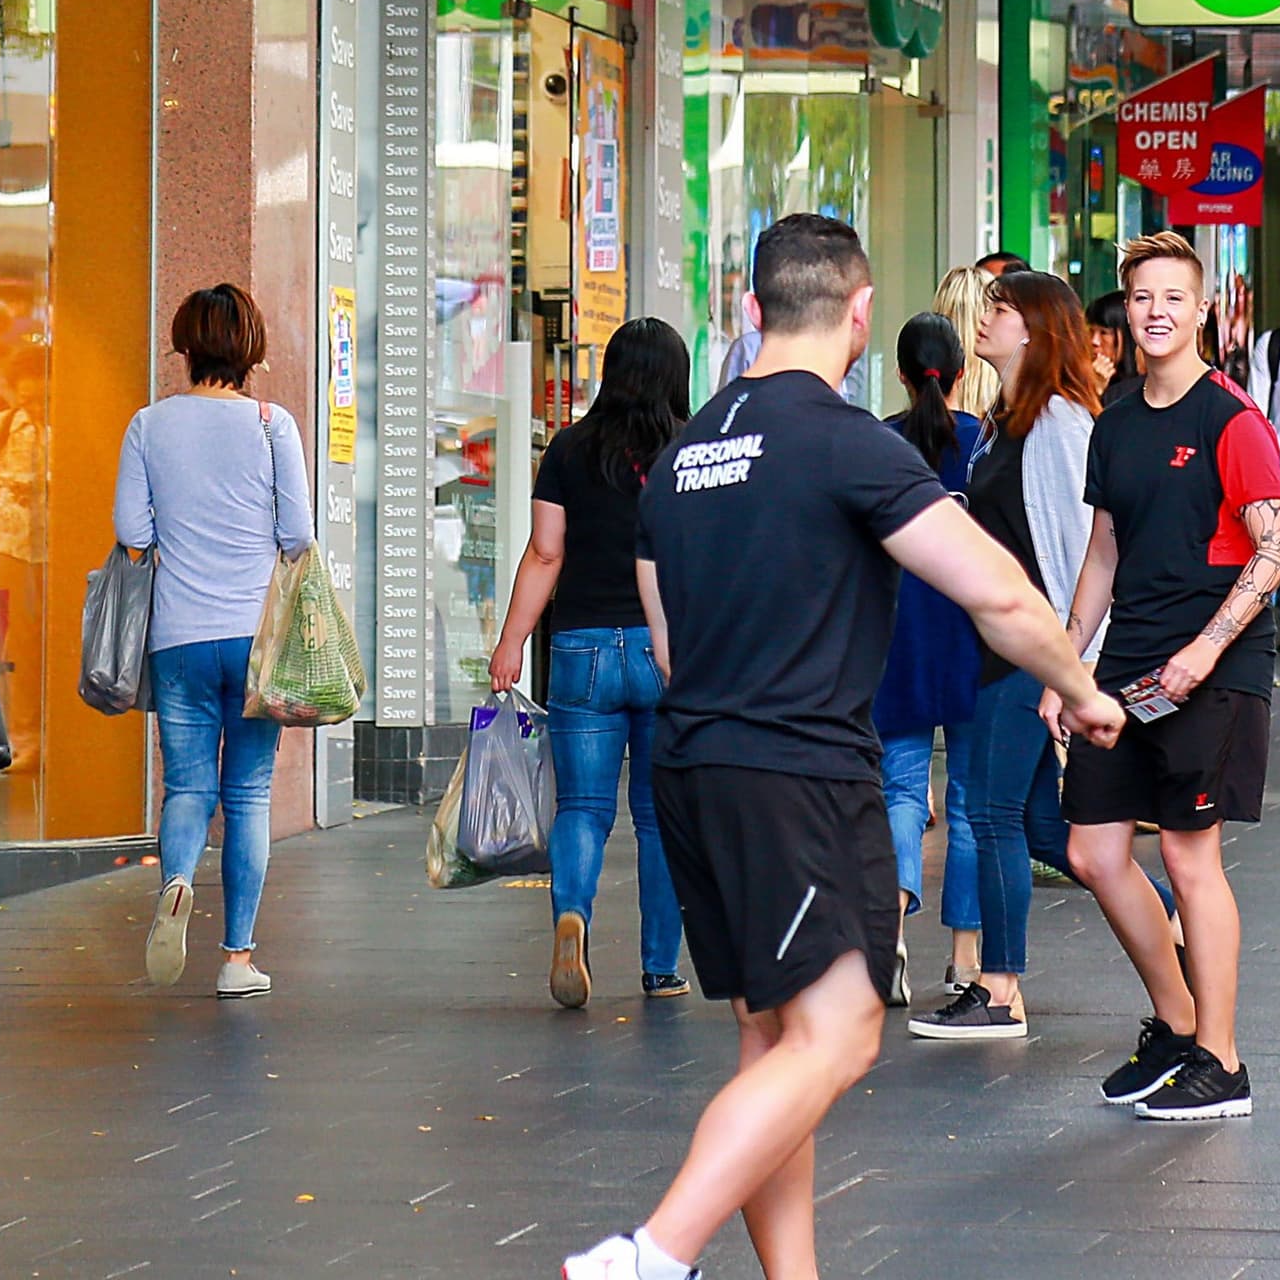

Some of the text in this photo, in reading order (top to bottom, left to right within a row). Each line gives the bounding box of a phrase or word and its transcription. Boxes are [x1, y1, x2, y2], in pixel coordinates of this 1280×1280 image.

[385, 3, 419, 17] Save
[385, 23, 419, 37] Save
[331, 25, 354, 68] Save
[385, 43, 419, 57] Save
[385, 63, 419, 77] Save
[385, 83, 419, 97] Save
[331, 91, 354, 134] Save
[385, 103, 419, 116] Save
[1121, 102, 1209, 123] CHEMIST
[385, 123, 419, 136] Save
[1135, 131, 1197, 150] OPEN
[385, 143, 419, 156] Save
[385, 162, 419, 176] Save
[330, 156, 353, 198] Save
[385, 182, 419, 196] Save
[385, 203, 419, 216] Save
[385, 223, 419, 236] Save
[329, 222, 353, 265] Save
[384, 243, 418, 256] Save
[384, 263, 418, 276] Save
[384, 283, 418, 296] Save
[384, 303, 418, 316] Save
[384, 323, 418, 337] Save
[384, 343, 418, 357] Save
[384, 363, 418, 376] Save
[384, 383, 418, 396] Save
[384, 403, 418, 417] Save
[384, 423, 418, 437] Save
[384, 443, 418, 457] Save
[672, 433, 766, 472] PERSONAL
[384, 463, 418, 477] Save
[674, 458, 753, 494] TRAINER
[384, 483, 418, 497] Save
[328, 484, 352, 524] Save
[384, 503, 418, 517] Save
[384, 523, 418, 537] Save
[383, 543, 417, 557] Save
[383, 564, 417, 577] Save
[383, 584, 417, 598] Save
[383, 604, 417, 618] Save
[383, 624, 417, 638] Save
[383, 644, 417, 658] Save
[383, 665, 417, 679] Save
[383, 685, 417, 699] Save
[383, 706, 417, 719] Save
